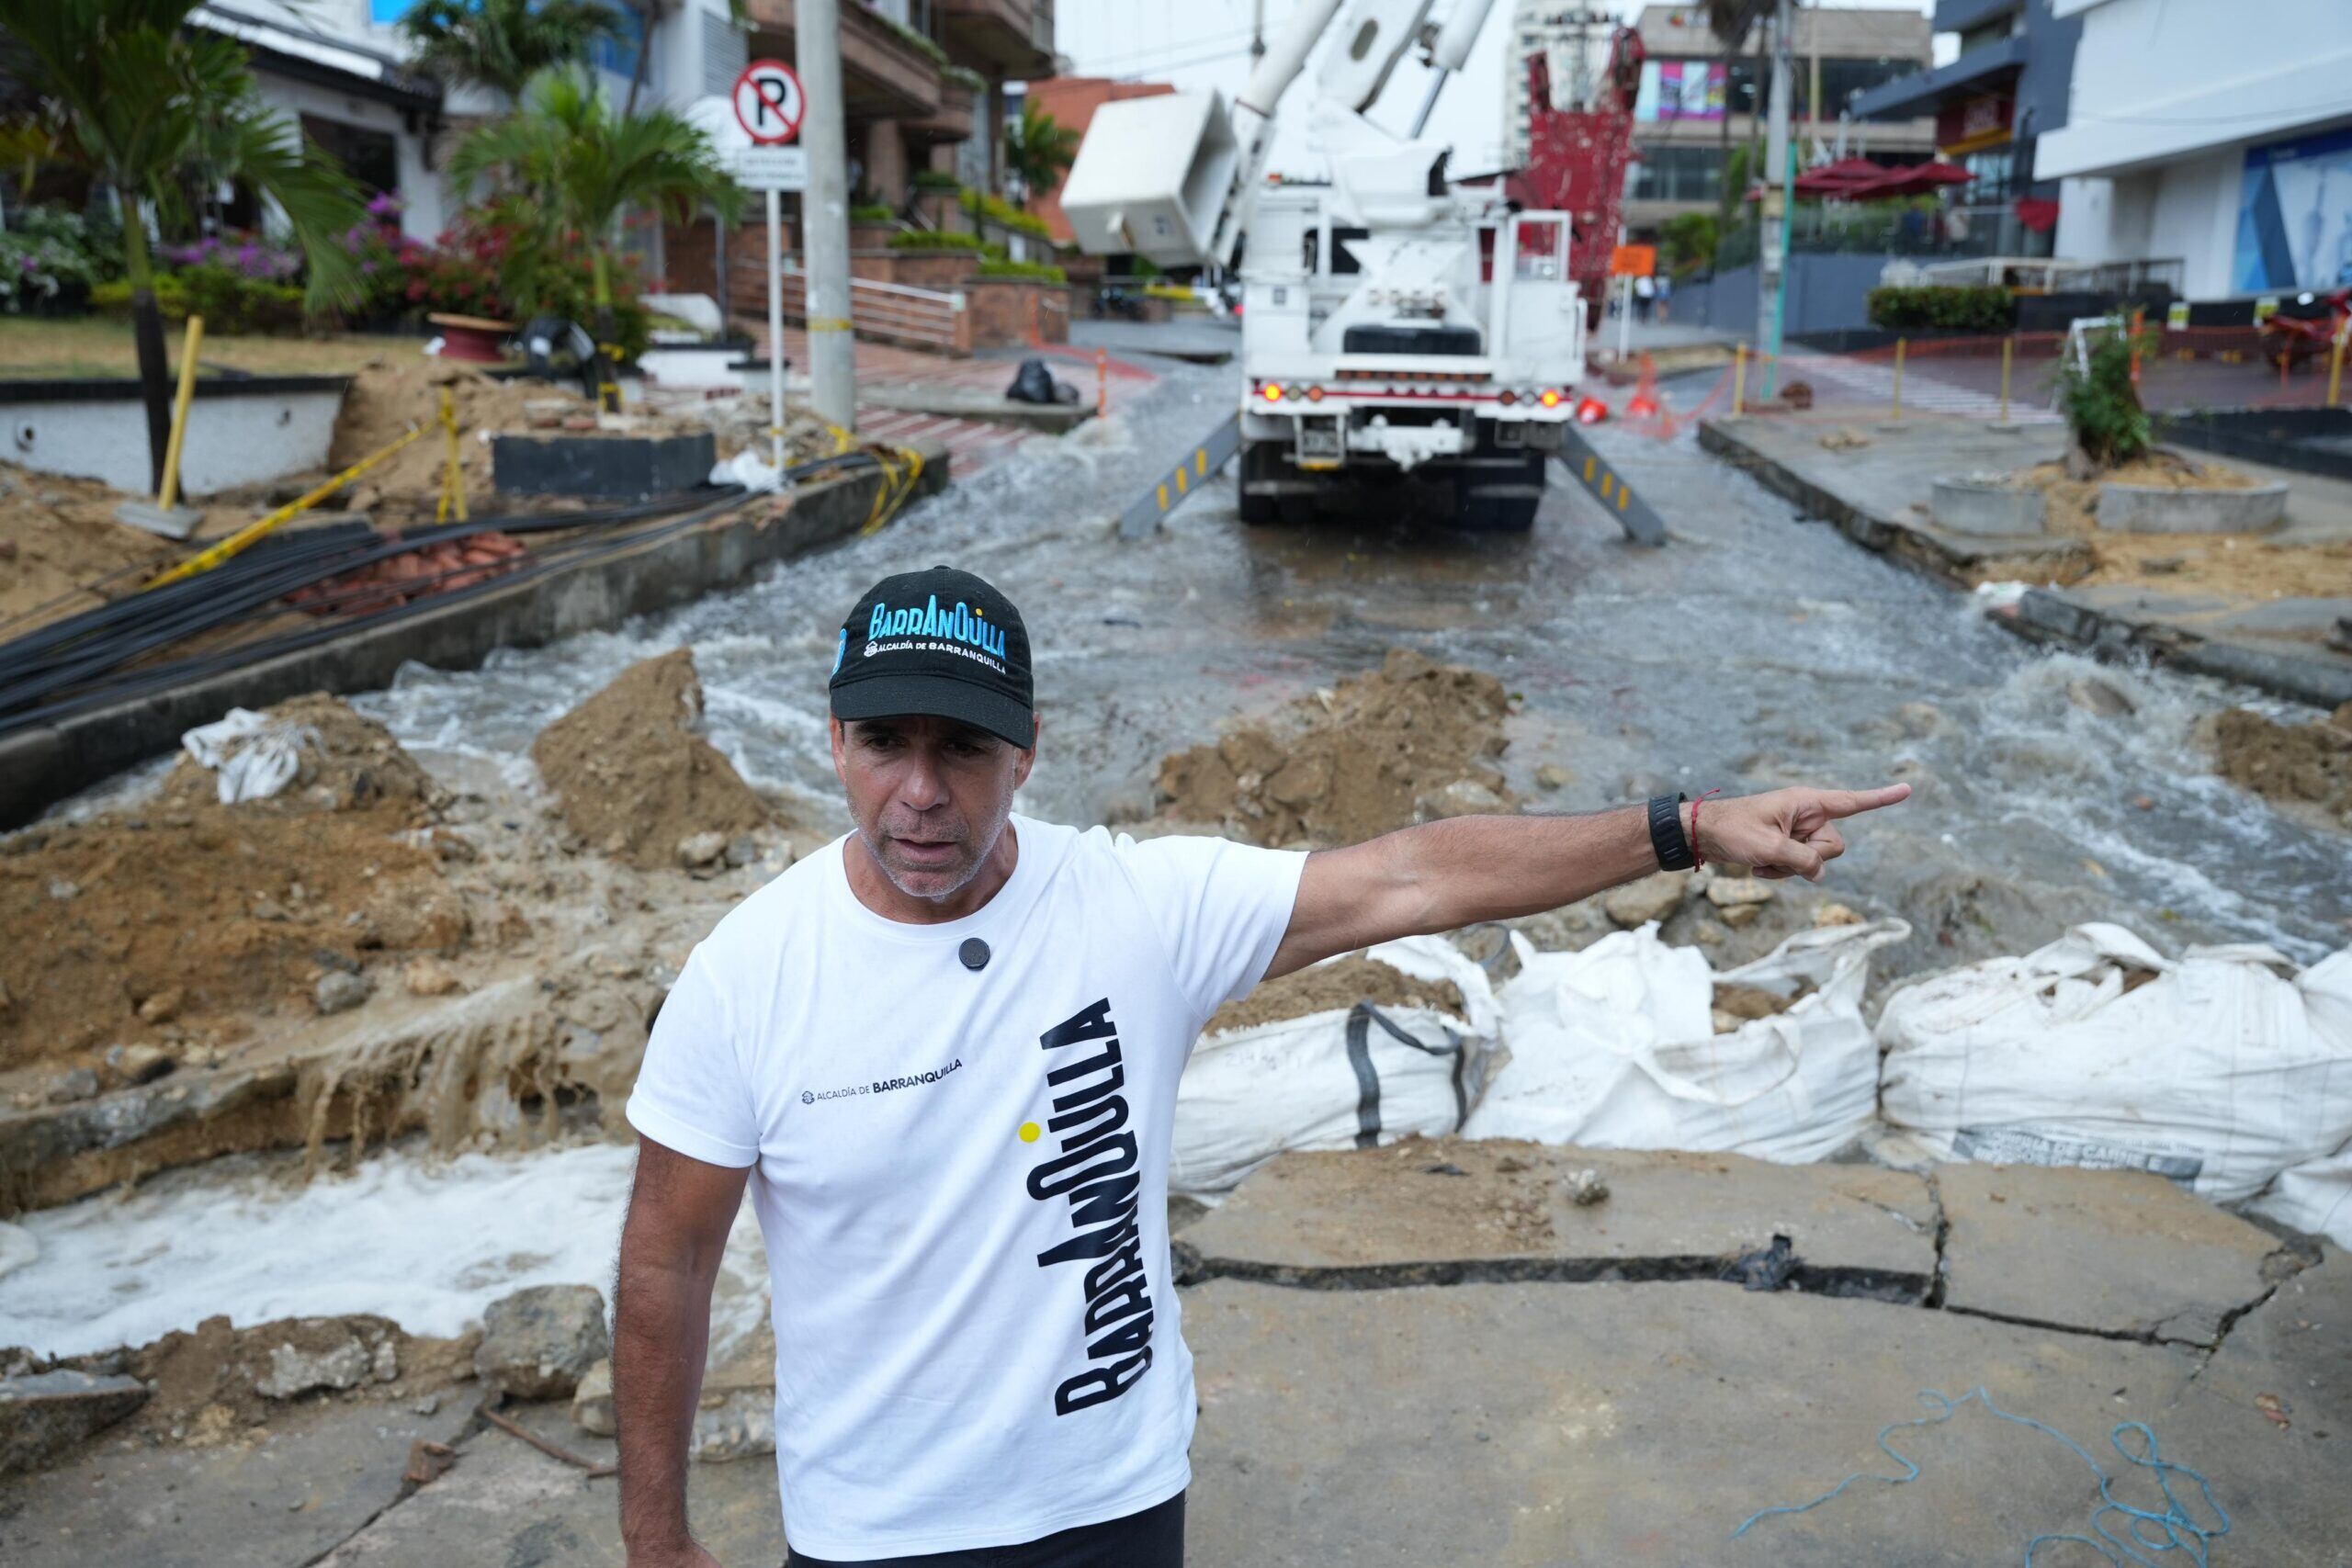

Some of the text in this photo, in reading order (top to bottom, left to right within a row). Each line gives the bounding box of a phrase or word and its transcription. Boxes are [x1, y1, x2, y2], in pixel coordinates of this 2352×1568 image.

[755, 78, 786, 127] P
[868, 594, 1006, 661] BARRANQUILLA
[877, 640, 1006, 675] ALCALDÍA DE BARRANQUILLA
[817, 1058, 963, 1100] ALCALDÍA DE BARRANQUILLA
[1018, 997, 1153, 1416] BARRANQUILLA
